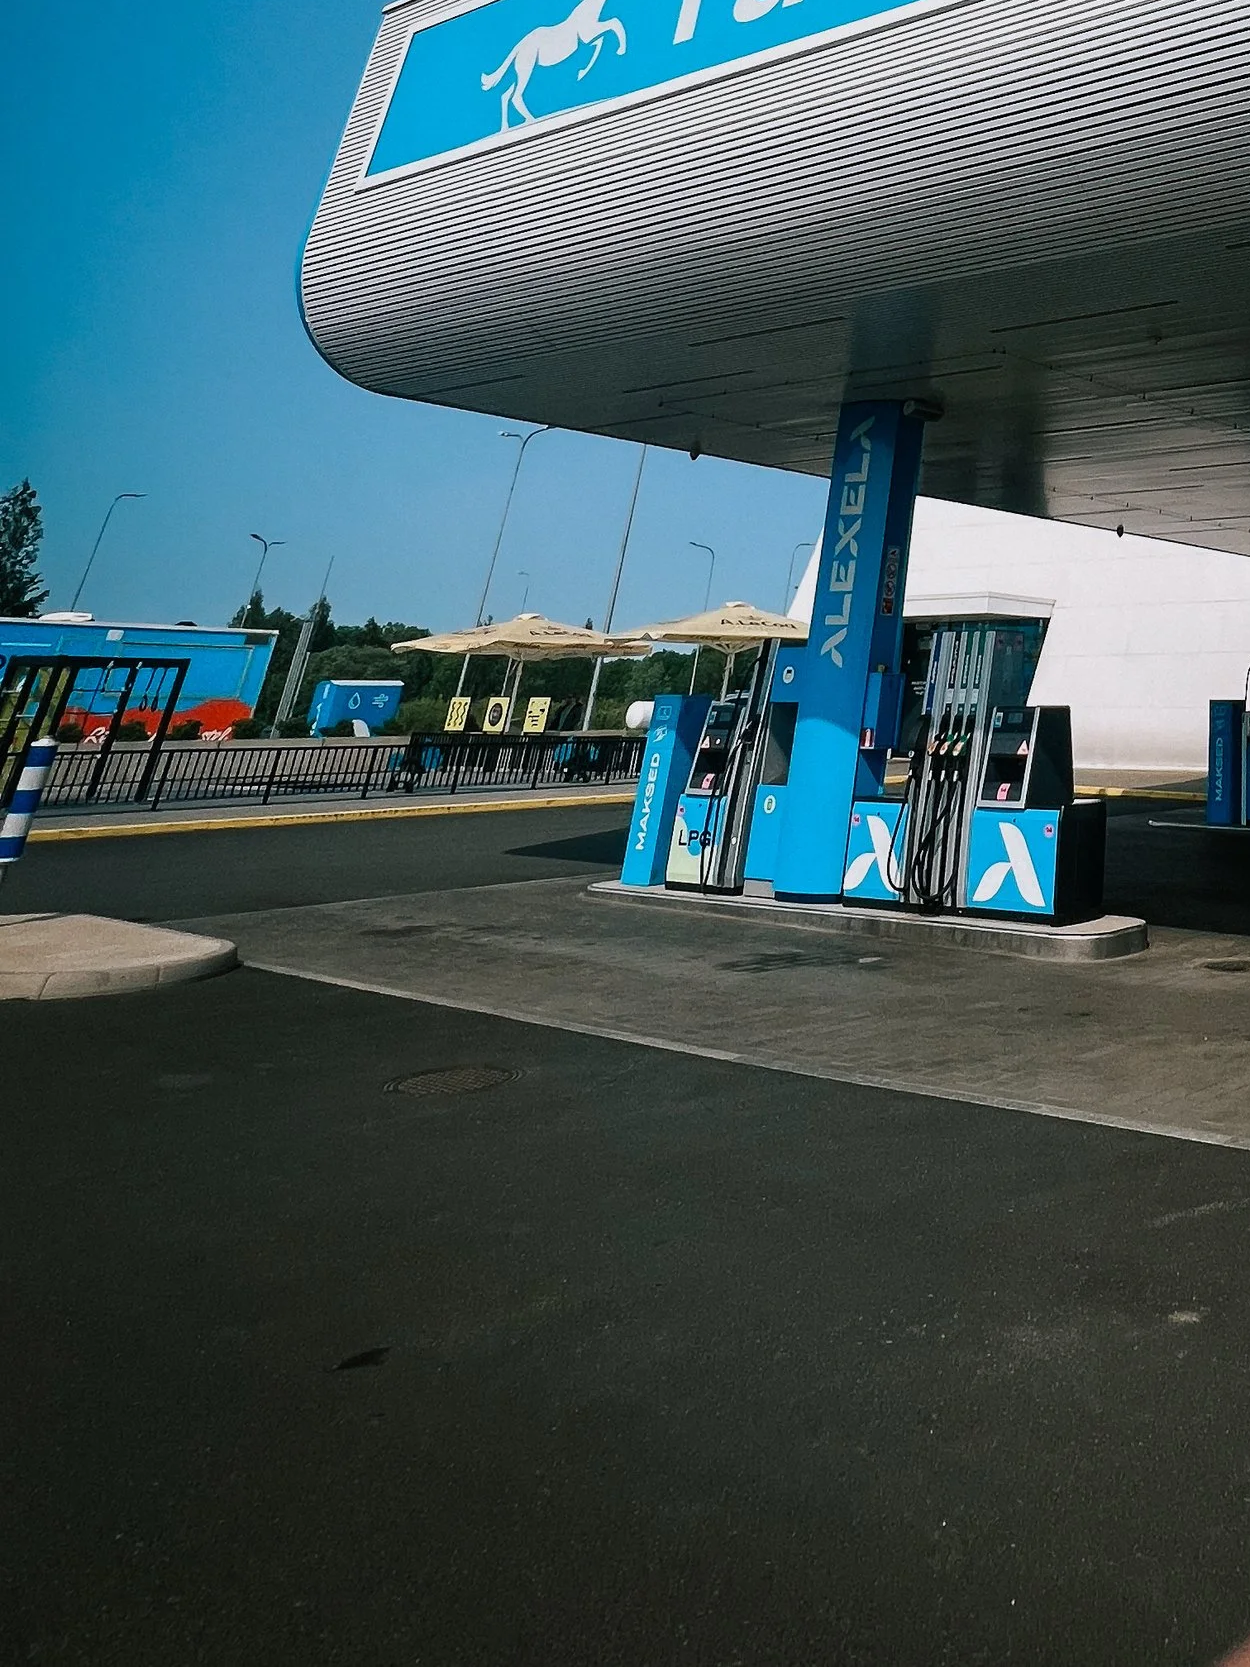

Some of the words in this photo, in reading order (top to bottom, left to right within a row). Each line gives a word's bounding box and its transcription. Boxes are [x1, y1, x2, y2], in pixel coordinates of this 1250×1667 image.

[820, 415, 876, 668] ALEXELA
[635, 752, 661, 850] MAKSED
[1215, 736, 1224, 802] MAKSED
[678, 830, 712, 847] LPG
